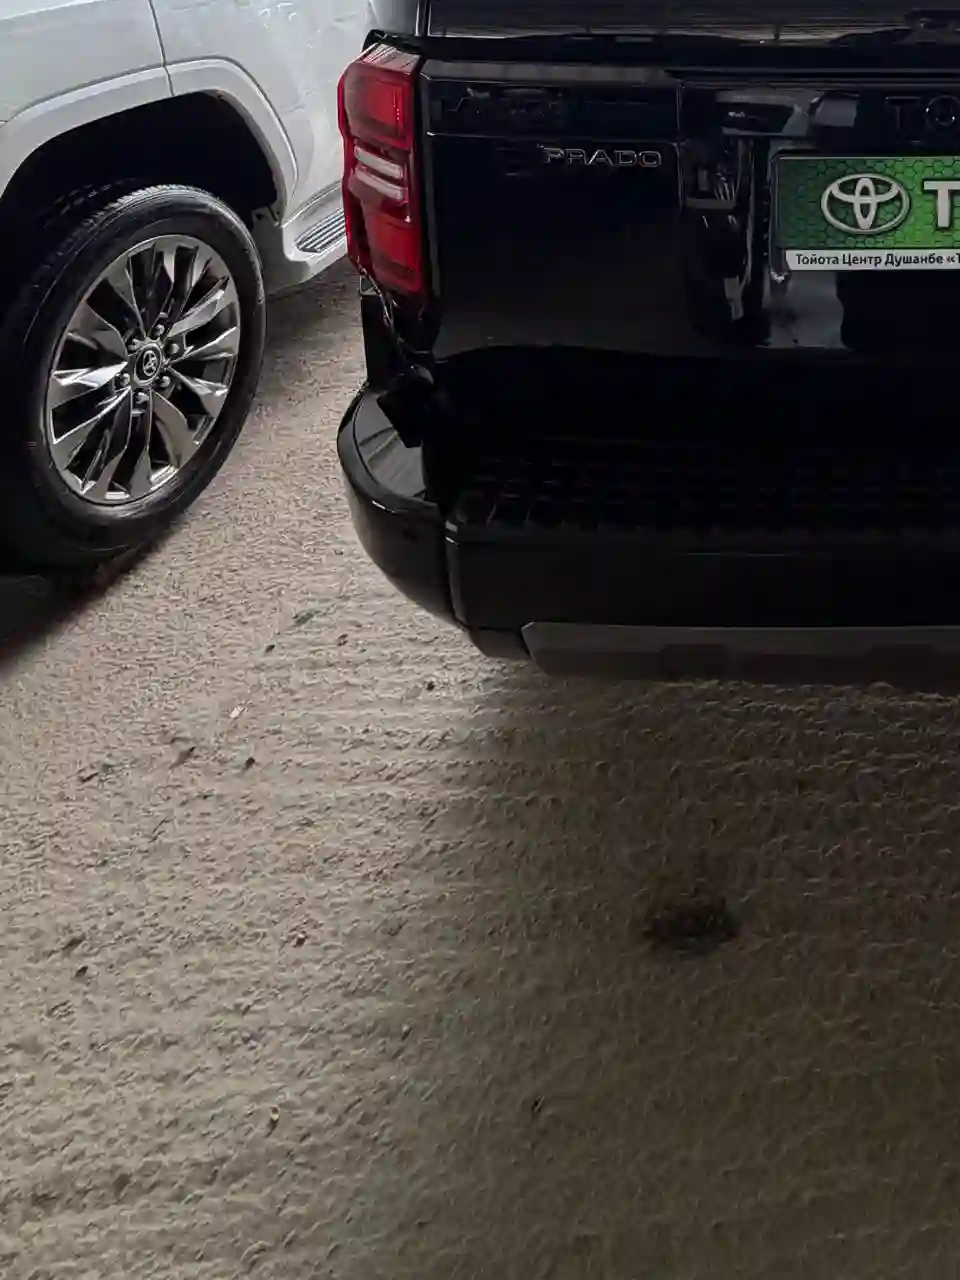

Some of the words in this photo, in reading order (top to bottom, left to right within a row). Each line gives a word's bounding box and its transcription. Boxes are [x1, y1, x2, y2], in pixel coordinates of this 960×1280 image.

[542, 147, 662, 168] PRADO
[795, 253, 839, 266] Тойота
[842, 253, 881, 267] Центр
[884, 253, 944, 267] Душанбе
